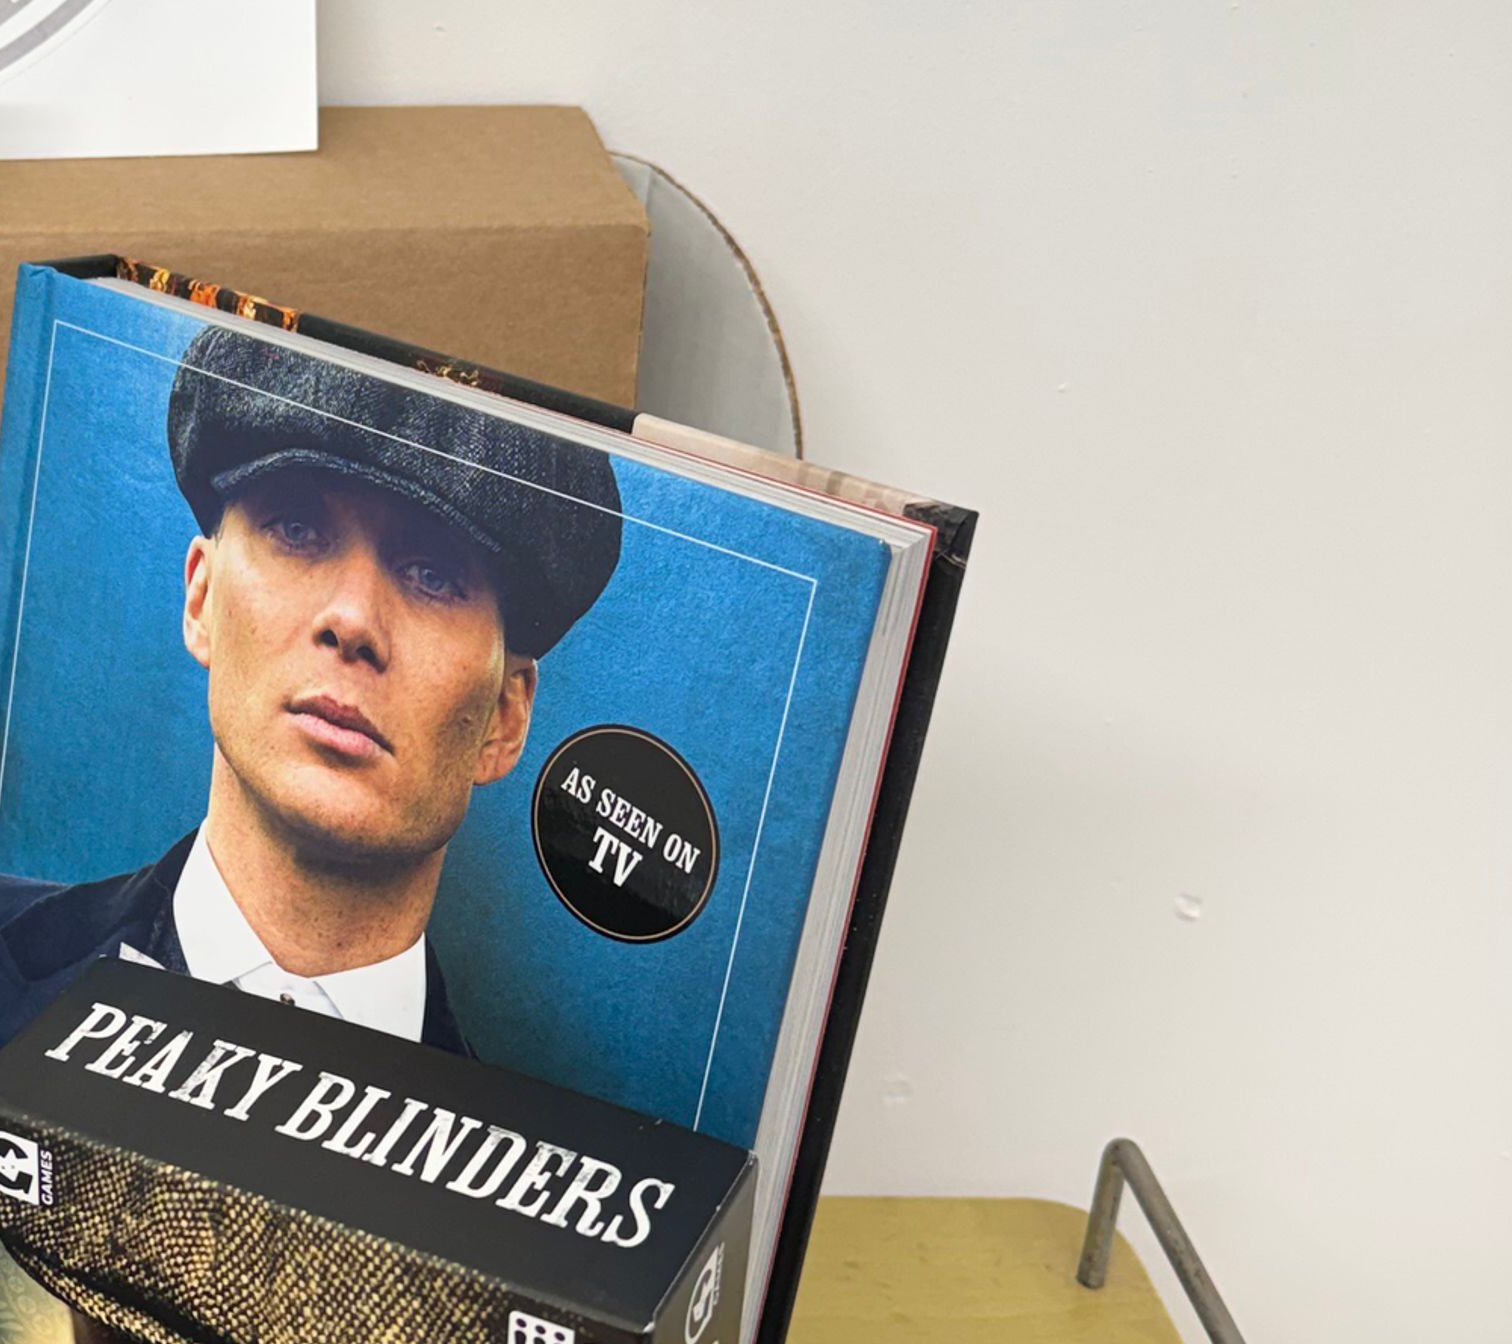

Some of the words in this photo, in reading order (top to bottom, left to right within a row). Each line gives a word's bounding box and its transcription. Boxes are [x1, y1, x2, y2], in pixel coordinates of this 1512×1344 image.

[560, 767, 596, 804] AS
[595, 788, 663, 849] SEEN
[662, 833, 701, 874] ON
[588, 826, 643, 888] TV
[44, 1002, 302, 1122] PEAKY
[275, 1072, 677, 1249] BLINDERS
[40, 1150, 53, 1206] GAMES
